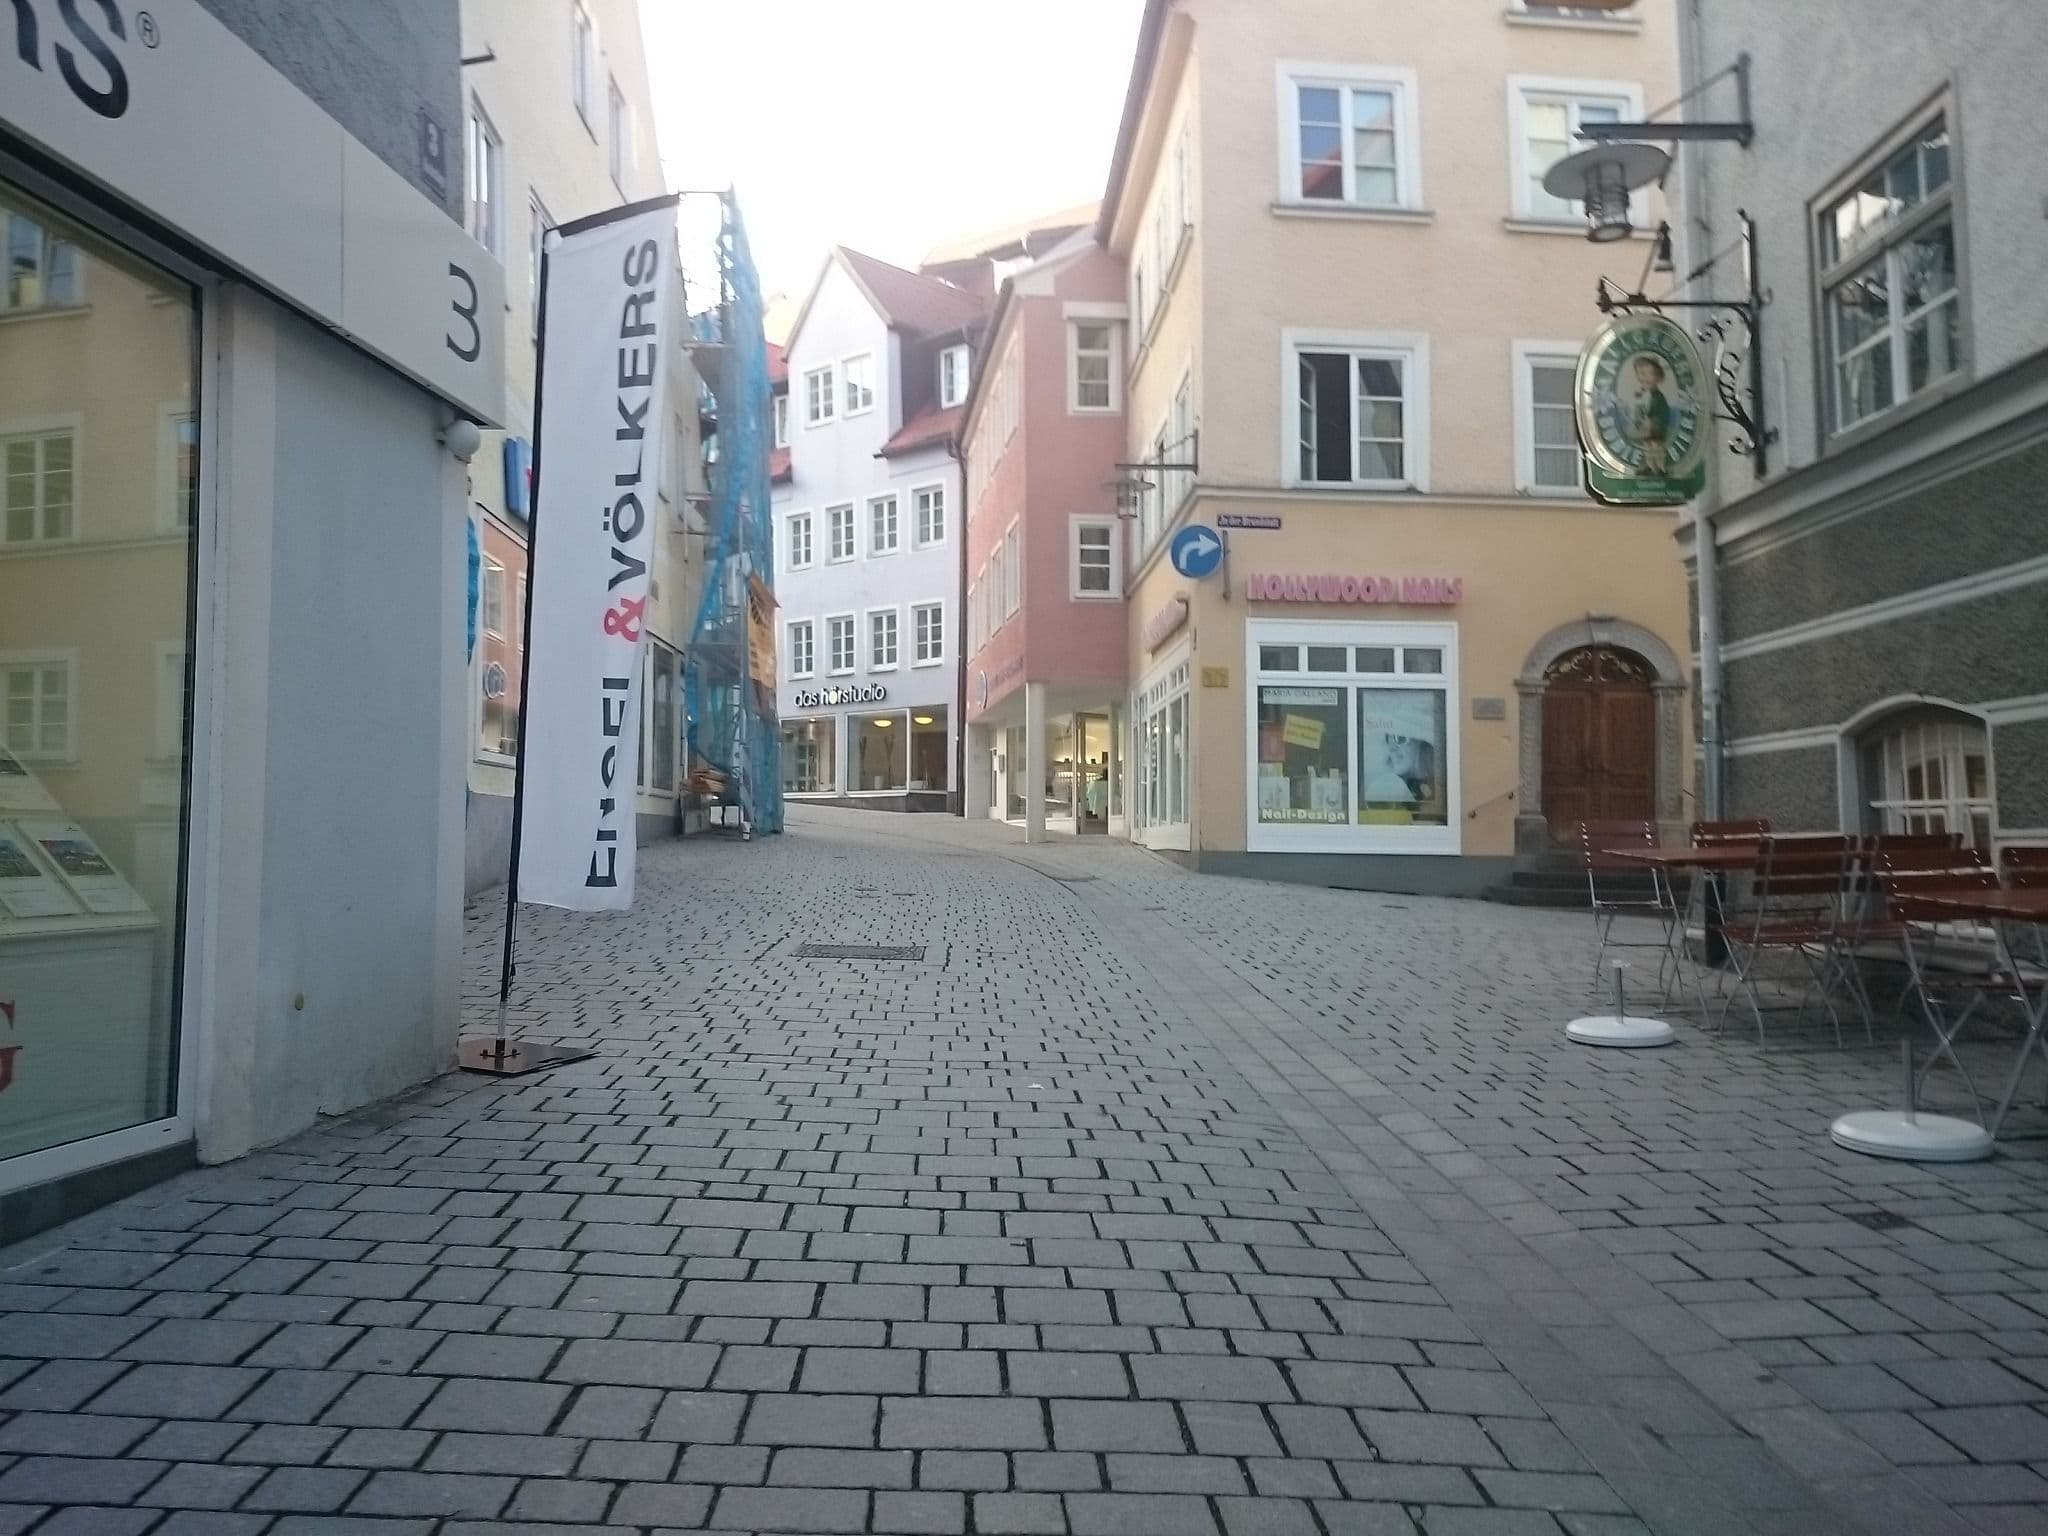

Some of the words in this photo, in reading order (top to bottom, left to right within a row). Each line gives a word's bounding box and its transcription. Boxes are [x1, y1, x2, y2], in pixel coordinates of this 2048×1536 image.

[446, 261, 480, 362] 3
[603, 239, 658, 592] VÖLKERS
[1249, 573, 1394, 604] HOLLYWOOD
[1401, 576, 1463, 605] NAILS
[604, 595, 647, 642] &
[794, 690, 819, 707] das
[820, 683, 887, 705] hörstudio
[1262, 808, 1346, 823] Nail-Design
